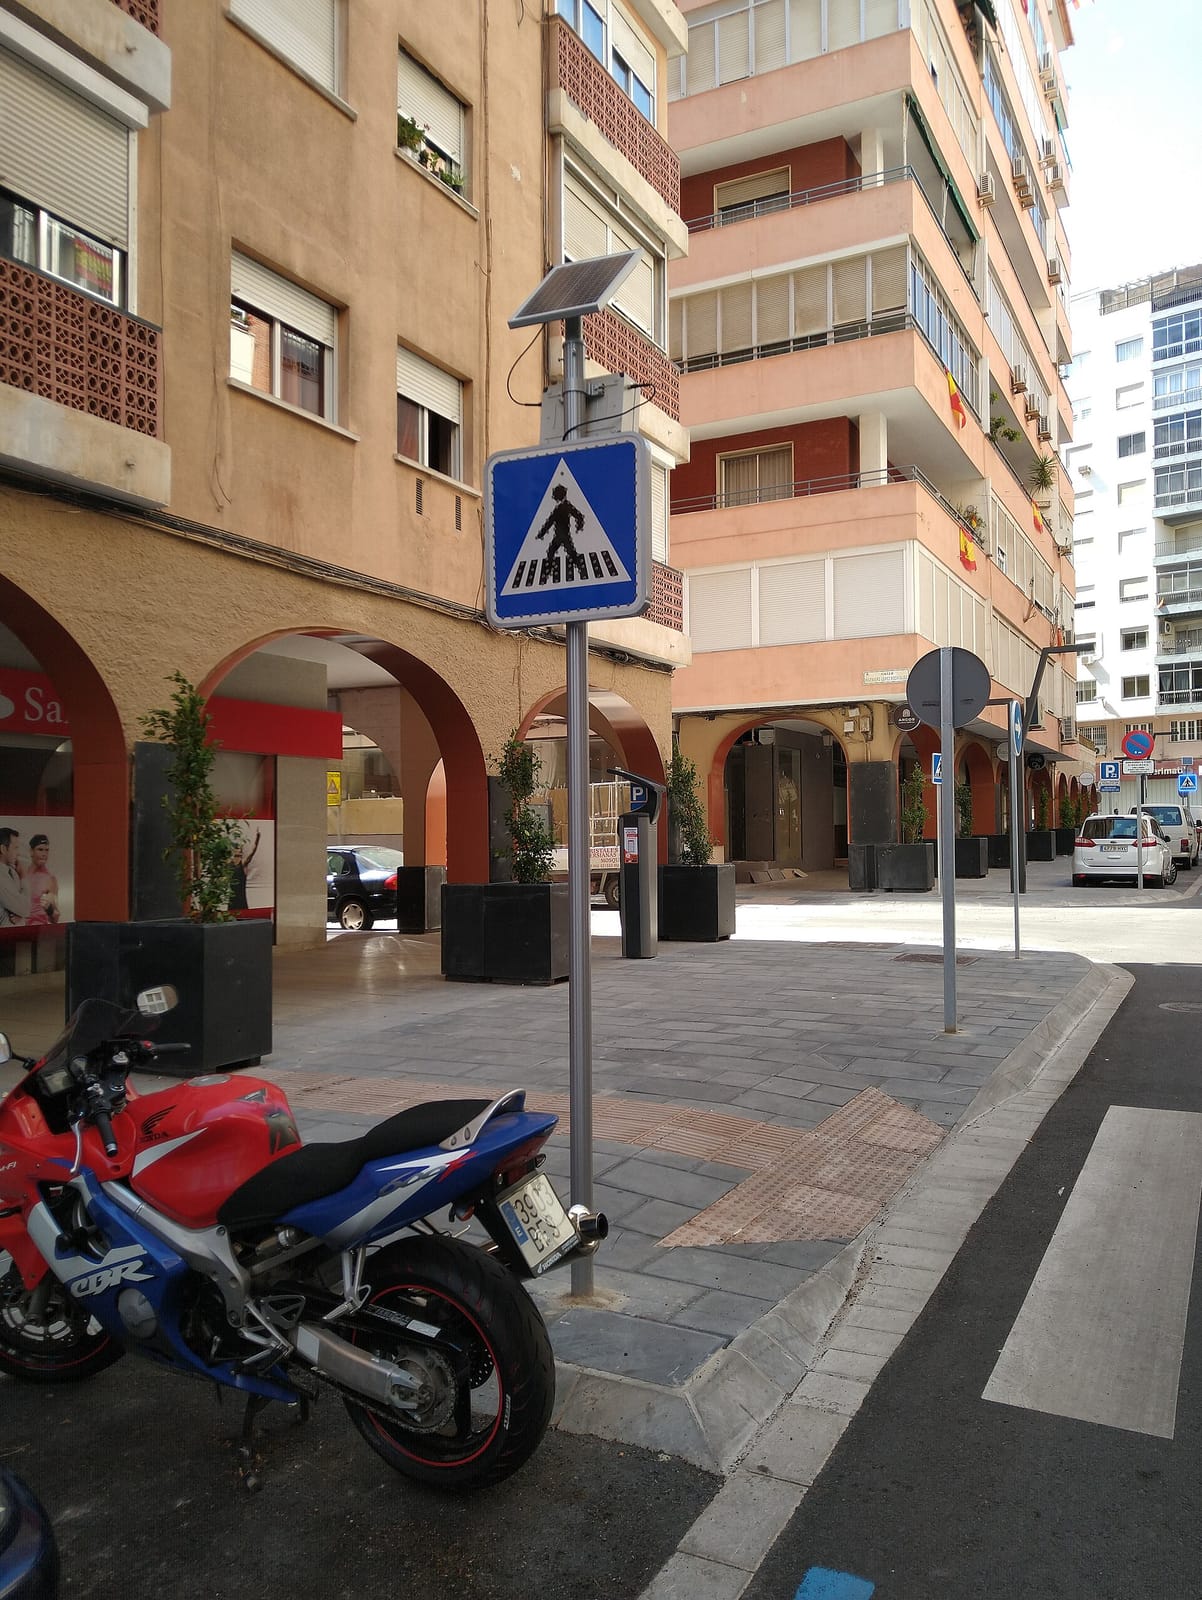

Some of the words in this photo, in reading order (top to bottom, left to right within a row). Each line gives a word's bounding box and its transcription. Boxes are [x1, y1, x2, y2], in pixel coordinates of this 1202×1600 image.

[24, 686, 69, 724] Sa
[632, 786, 644, 801] P
[70, 1259, 155, 1298] CBR
